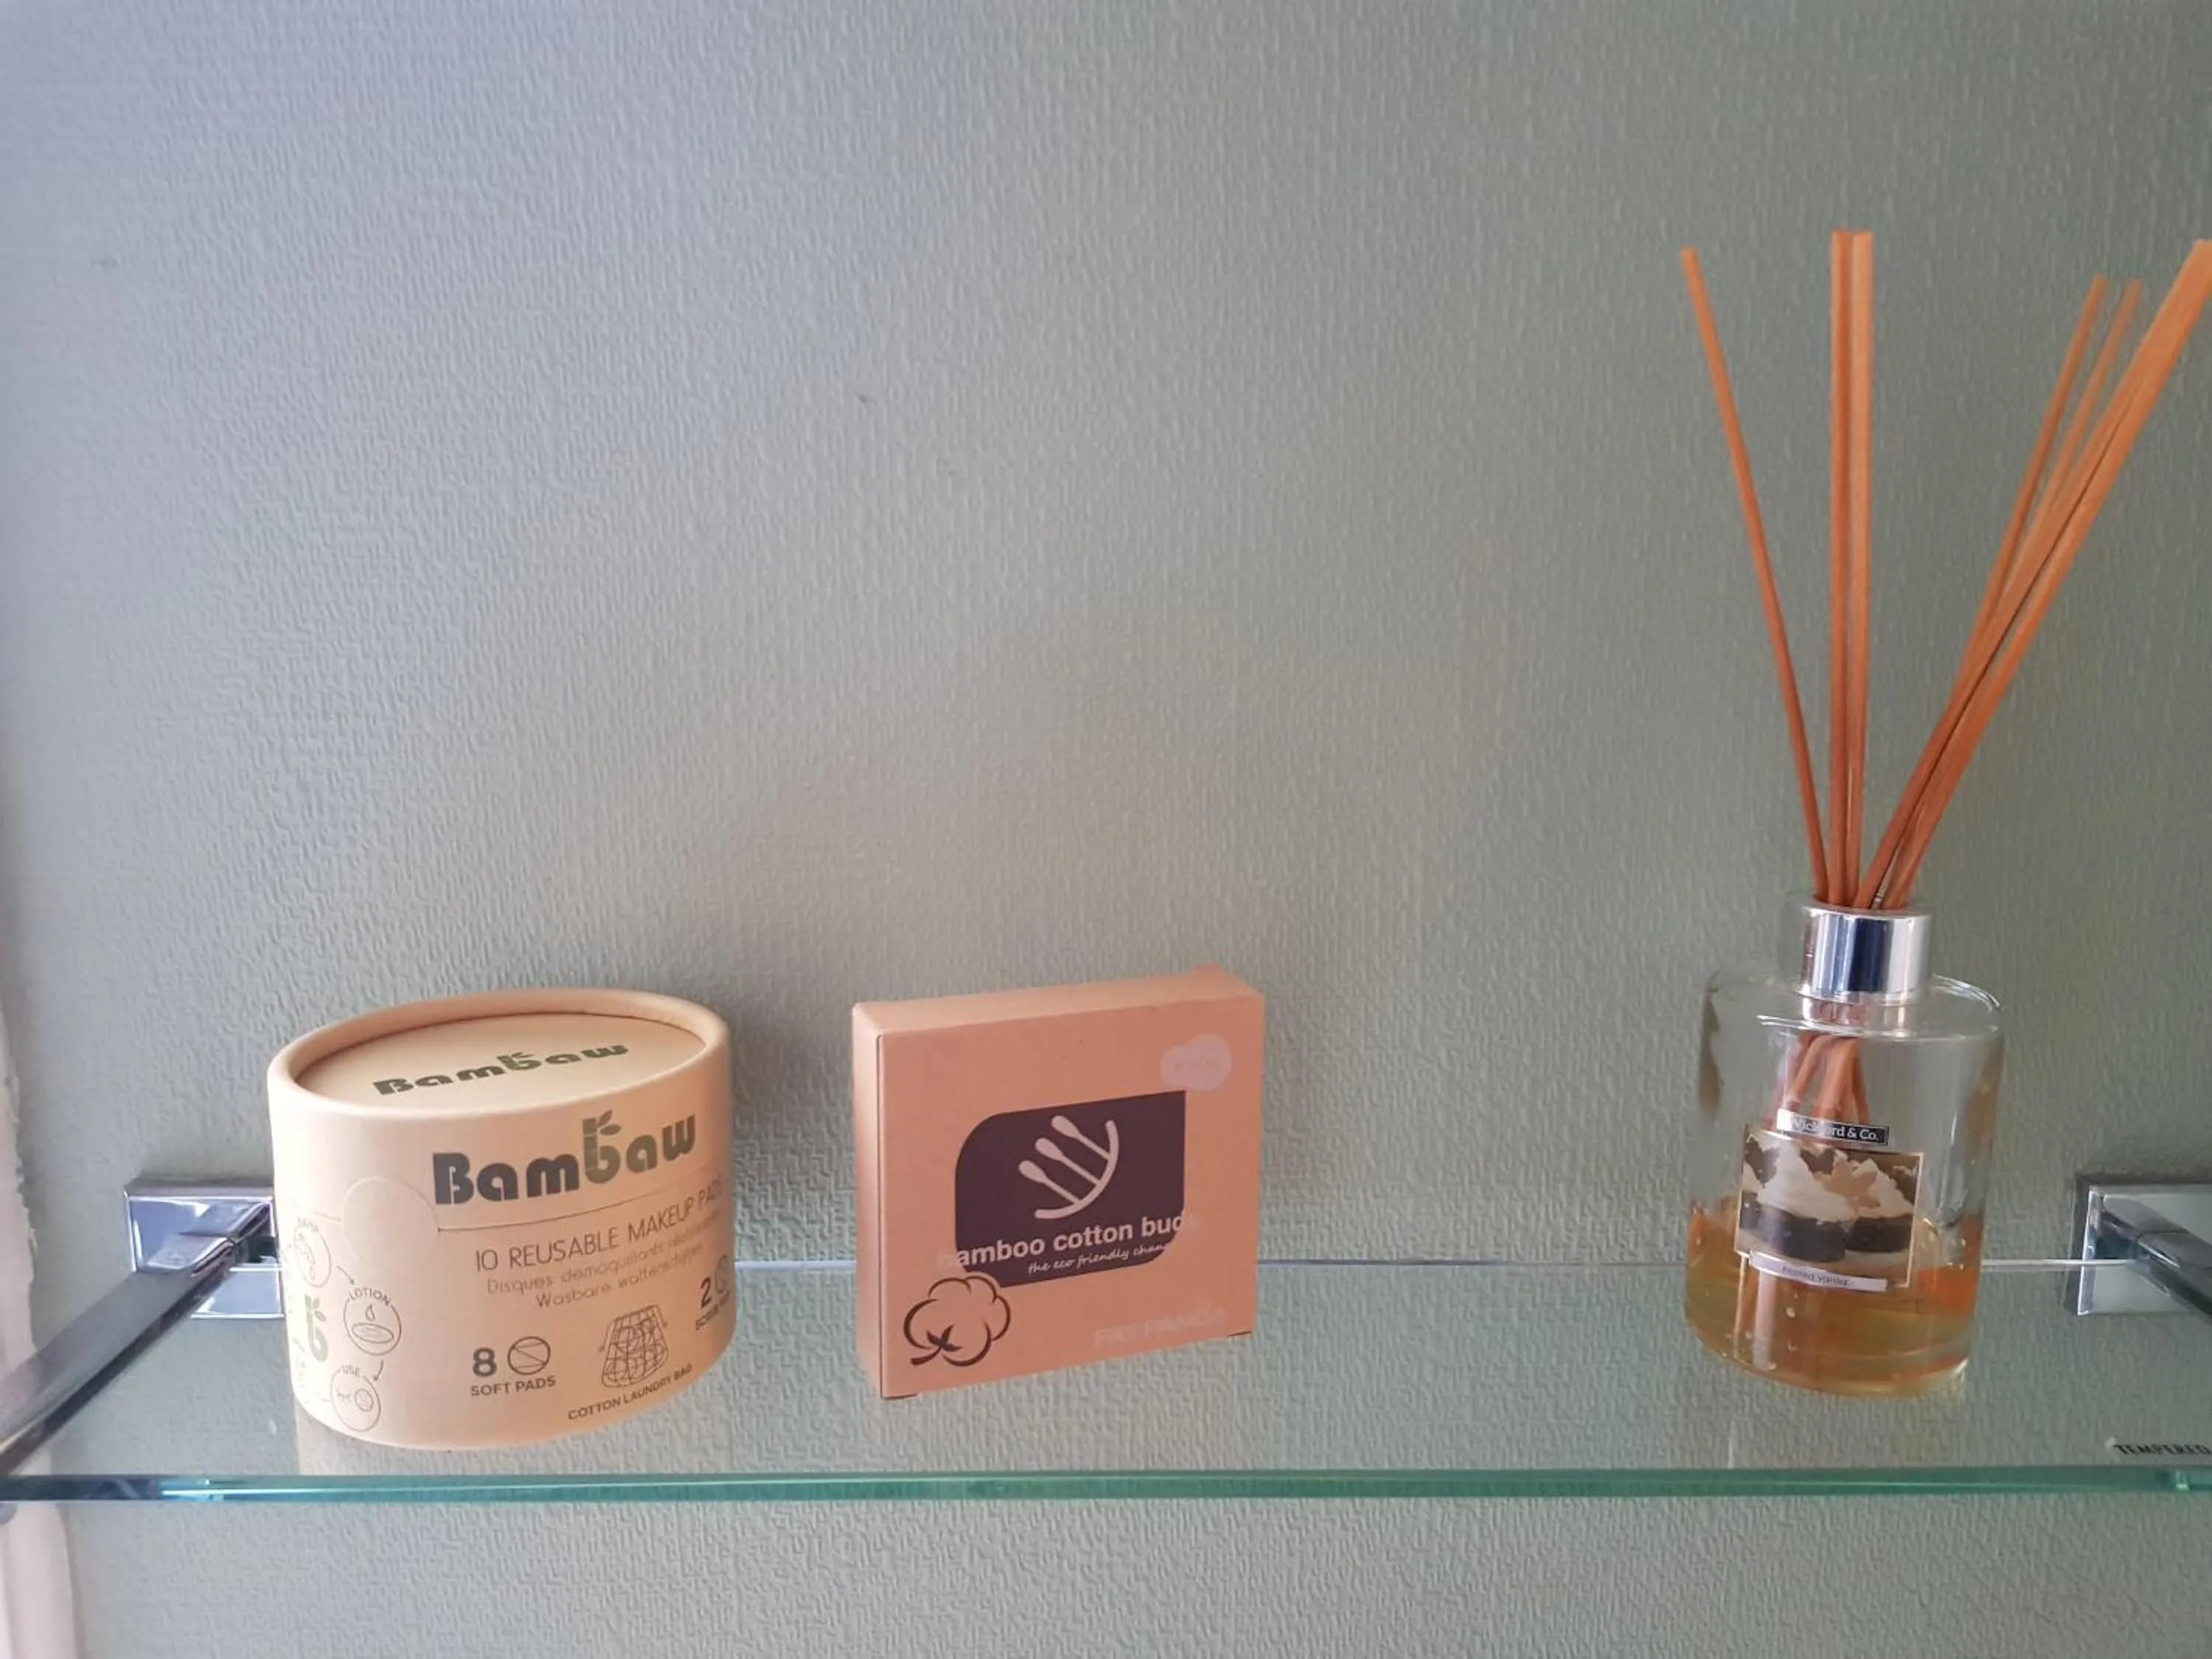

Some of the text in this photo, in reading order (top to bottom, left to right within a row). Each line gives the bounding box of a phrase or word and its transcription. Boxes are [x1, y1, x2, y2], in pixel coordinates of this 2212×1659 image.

[372, 1044, 628, 1095] Bambaw
[1848, 1126, 1857, 1139] &
[432, 1109, 695, 1205] Bambaw
[509, 1226, 620, 1269] REUSABLE
[627, 1197, 694, 1242] MAKEUP
[1053, 1222, 1133, 1253] cotton
[1027, 1260, 1051, 1275] the
[1054, 1257, 1076, 1270] eco
[1077, 1243, 1130, 1270] friendly
[349, 1286, 392, 1307] LOTION
[487, 1274, 554, 1299] Disques
[535, 1281, 613, 1310] Wasbare
[699, 1276, 712, 1310] 2
[472, 1347, 497, 1377] 8
[470, 1374, 557, 1397] SOFT PADS
[567, 1395, 622, 1420] COTTON
[622, 1376, 672, 1404] LAUNDRY
